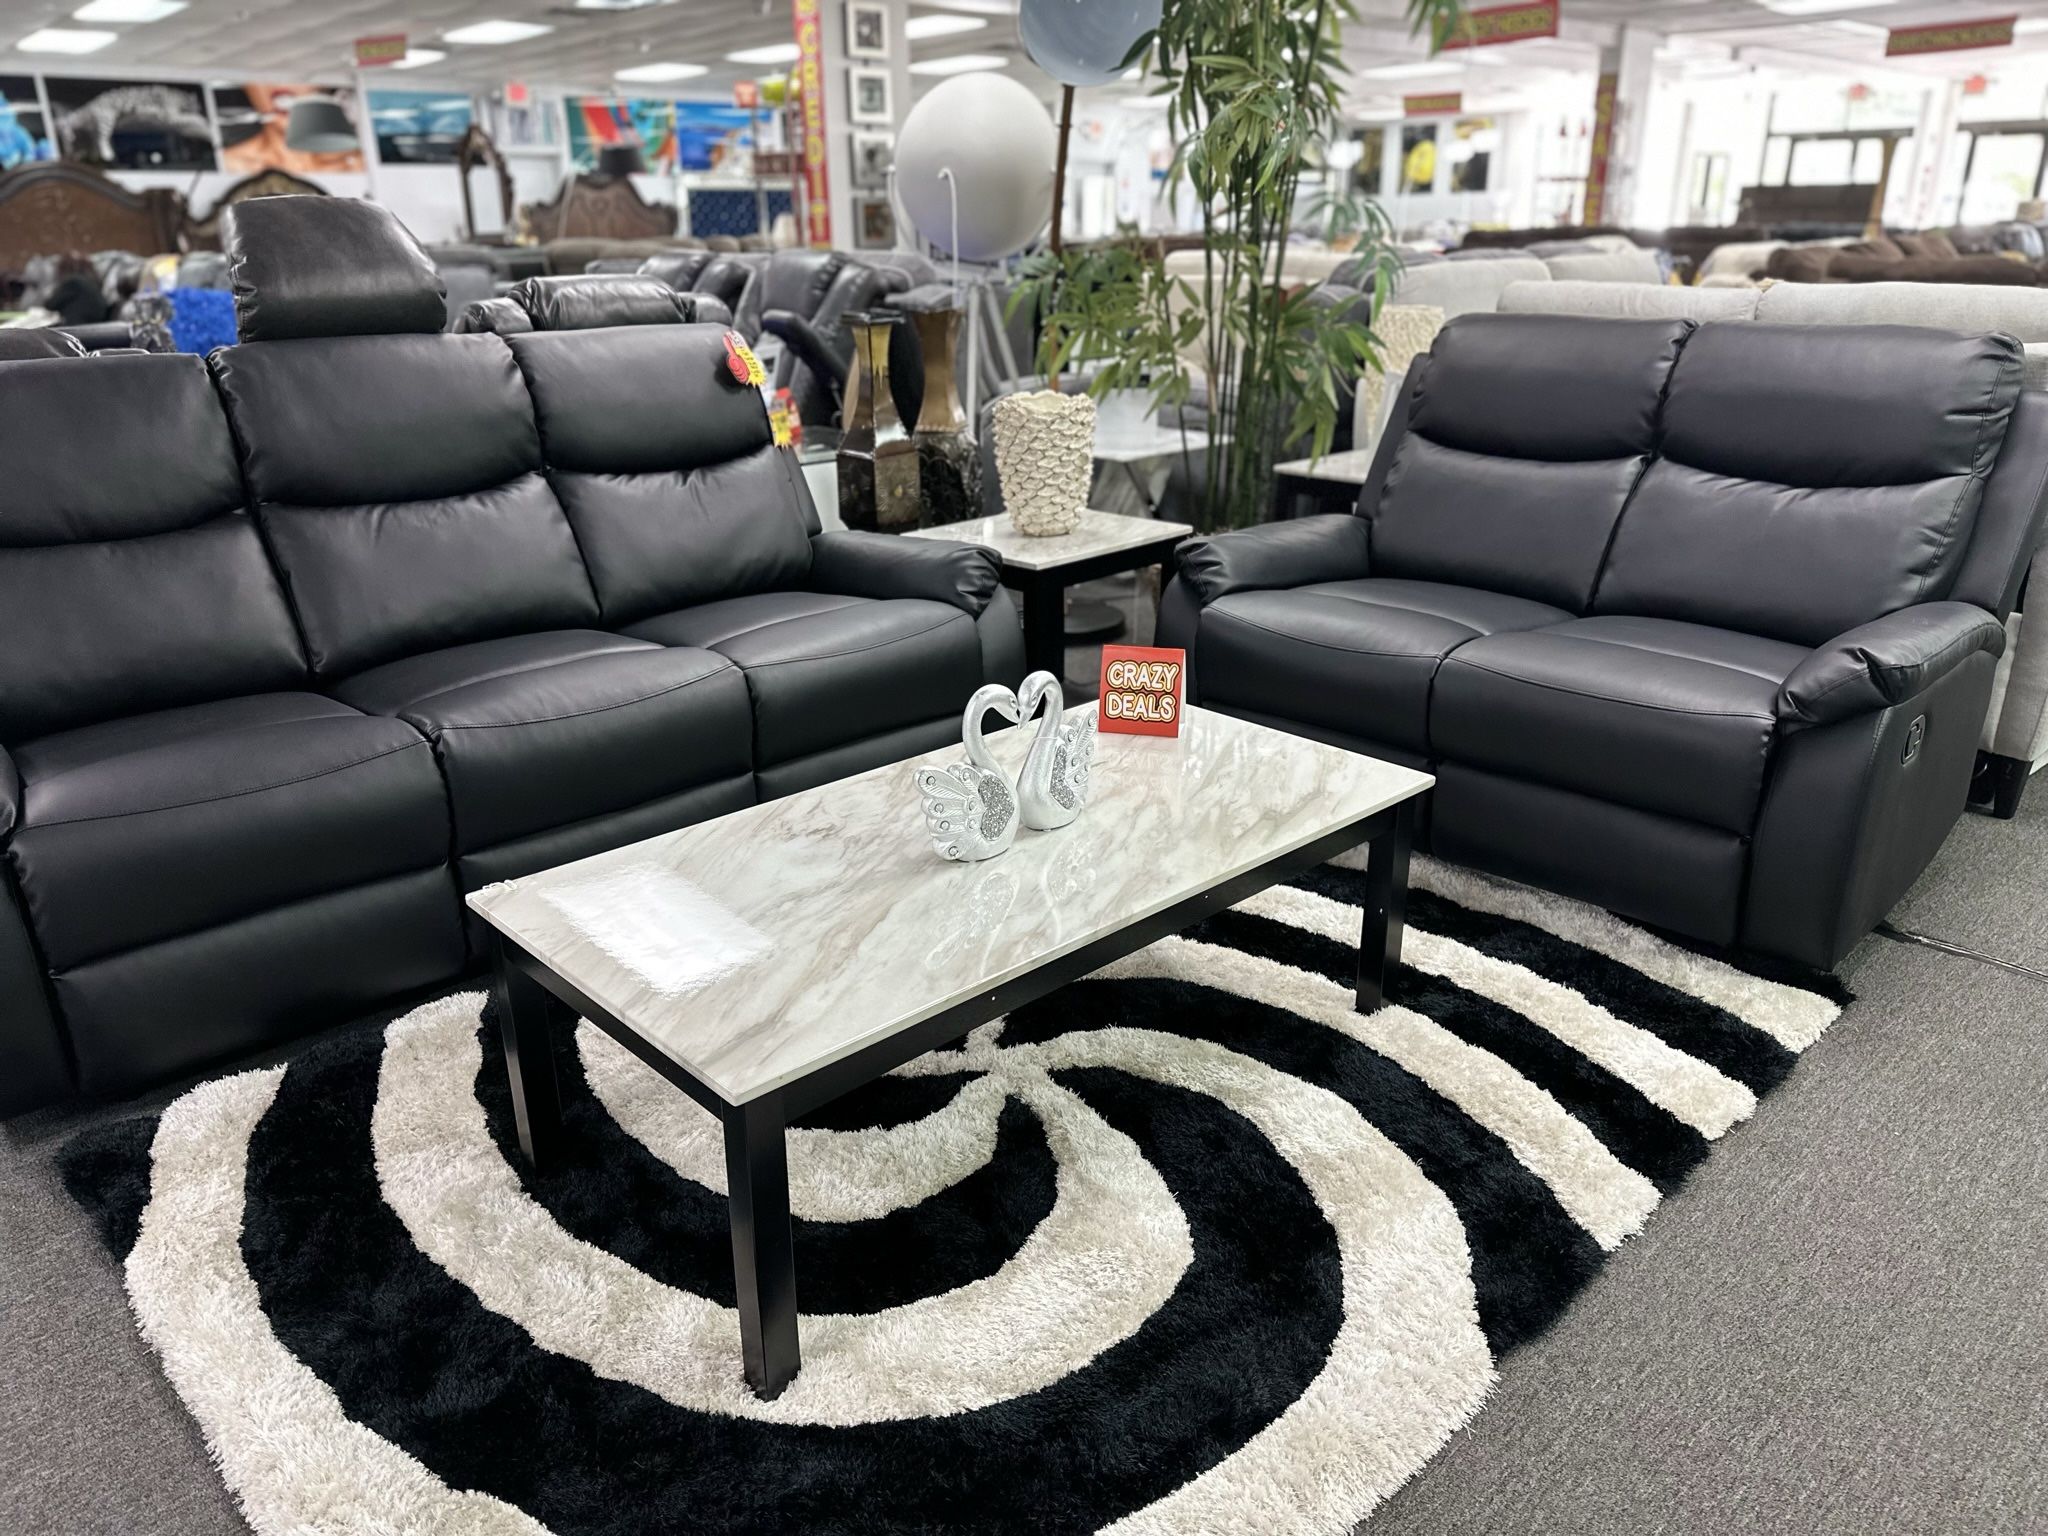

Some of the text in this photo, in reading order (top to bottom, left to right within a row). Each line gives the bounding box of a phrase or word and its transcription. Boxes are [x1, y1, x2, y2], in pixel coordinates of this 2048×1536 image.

[799, 22, 828, 238] CREDIT
[1107, 661, 1180, 692] CRAZY
[1105, 692, 1177, 723] DEALS
